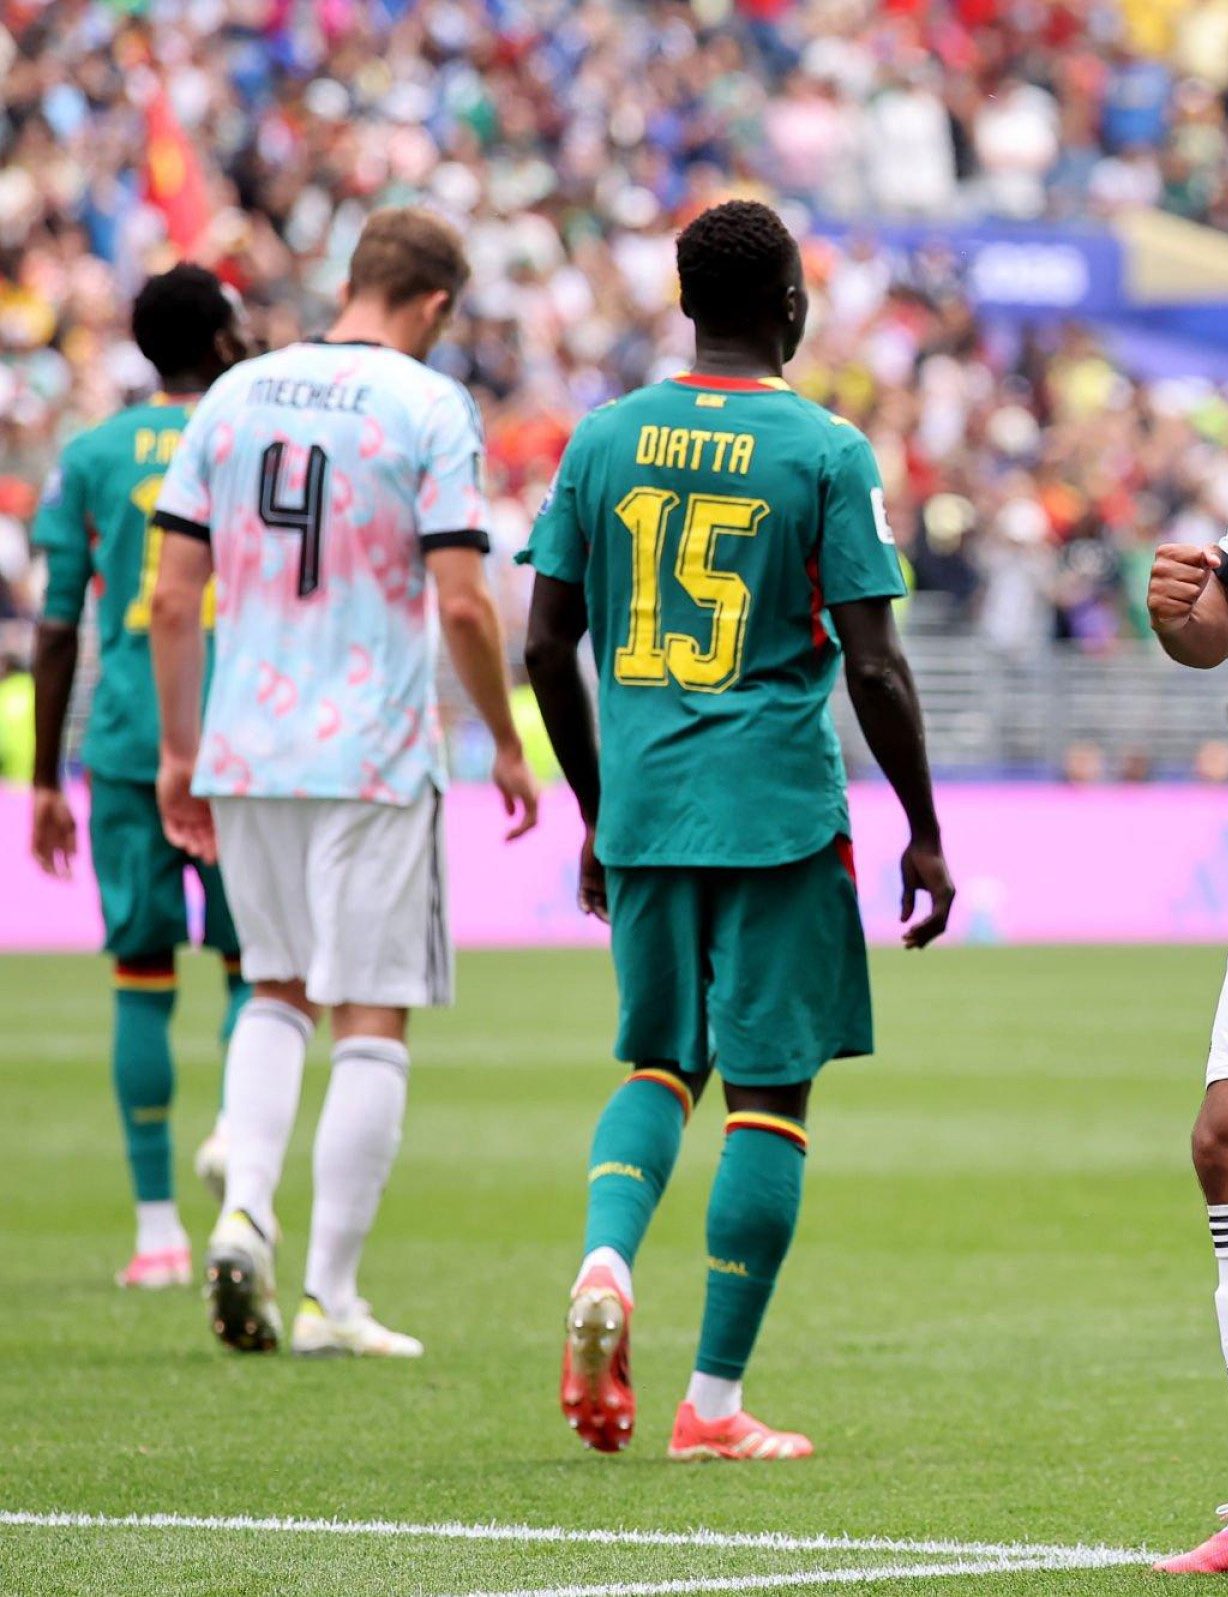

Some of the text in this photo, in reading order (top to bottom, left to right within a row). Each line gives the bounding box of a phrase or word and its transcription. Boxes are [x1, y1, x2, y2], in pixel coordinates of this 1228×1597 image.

[259, 441, 325, 598] 4
[636, 425, 754, 475] DIATTA
[614, 487, 770, 694] 15
